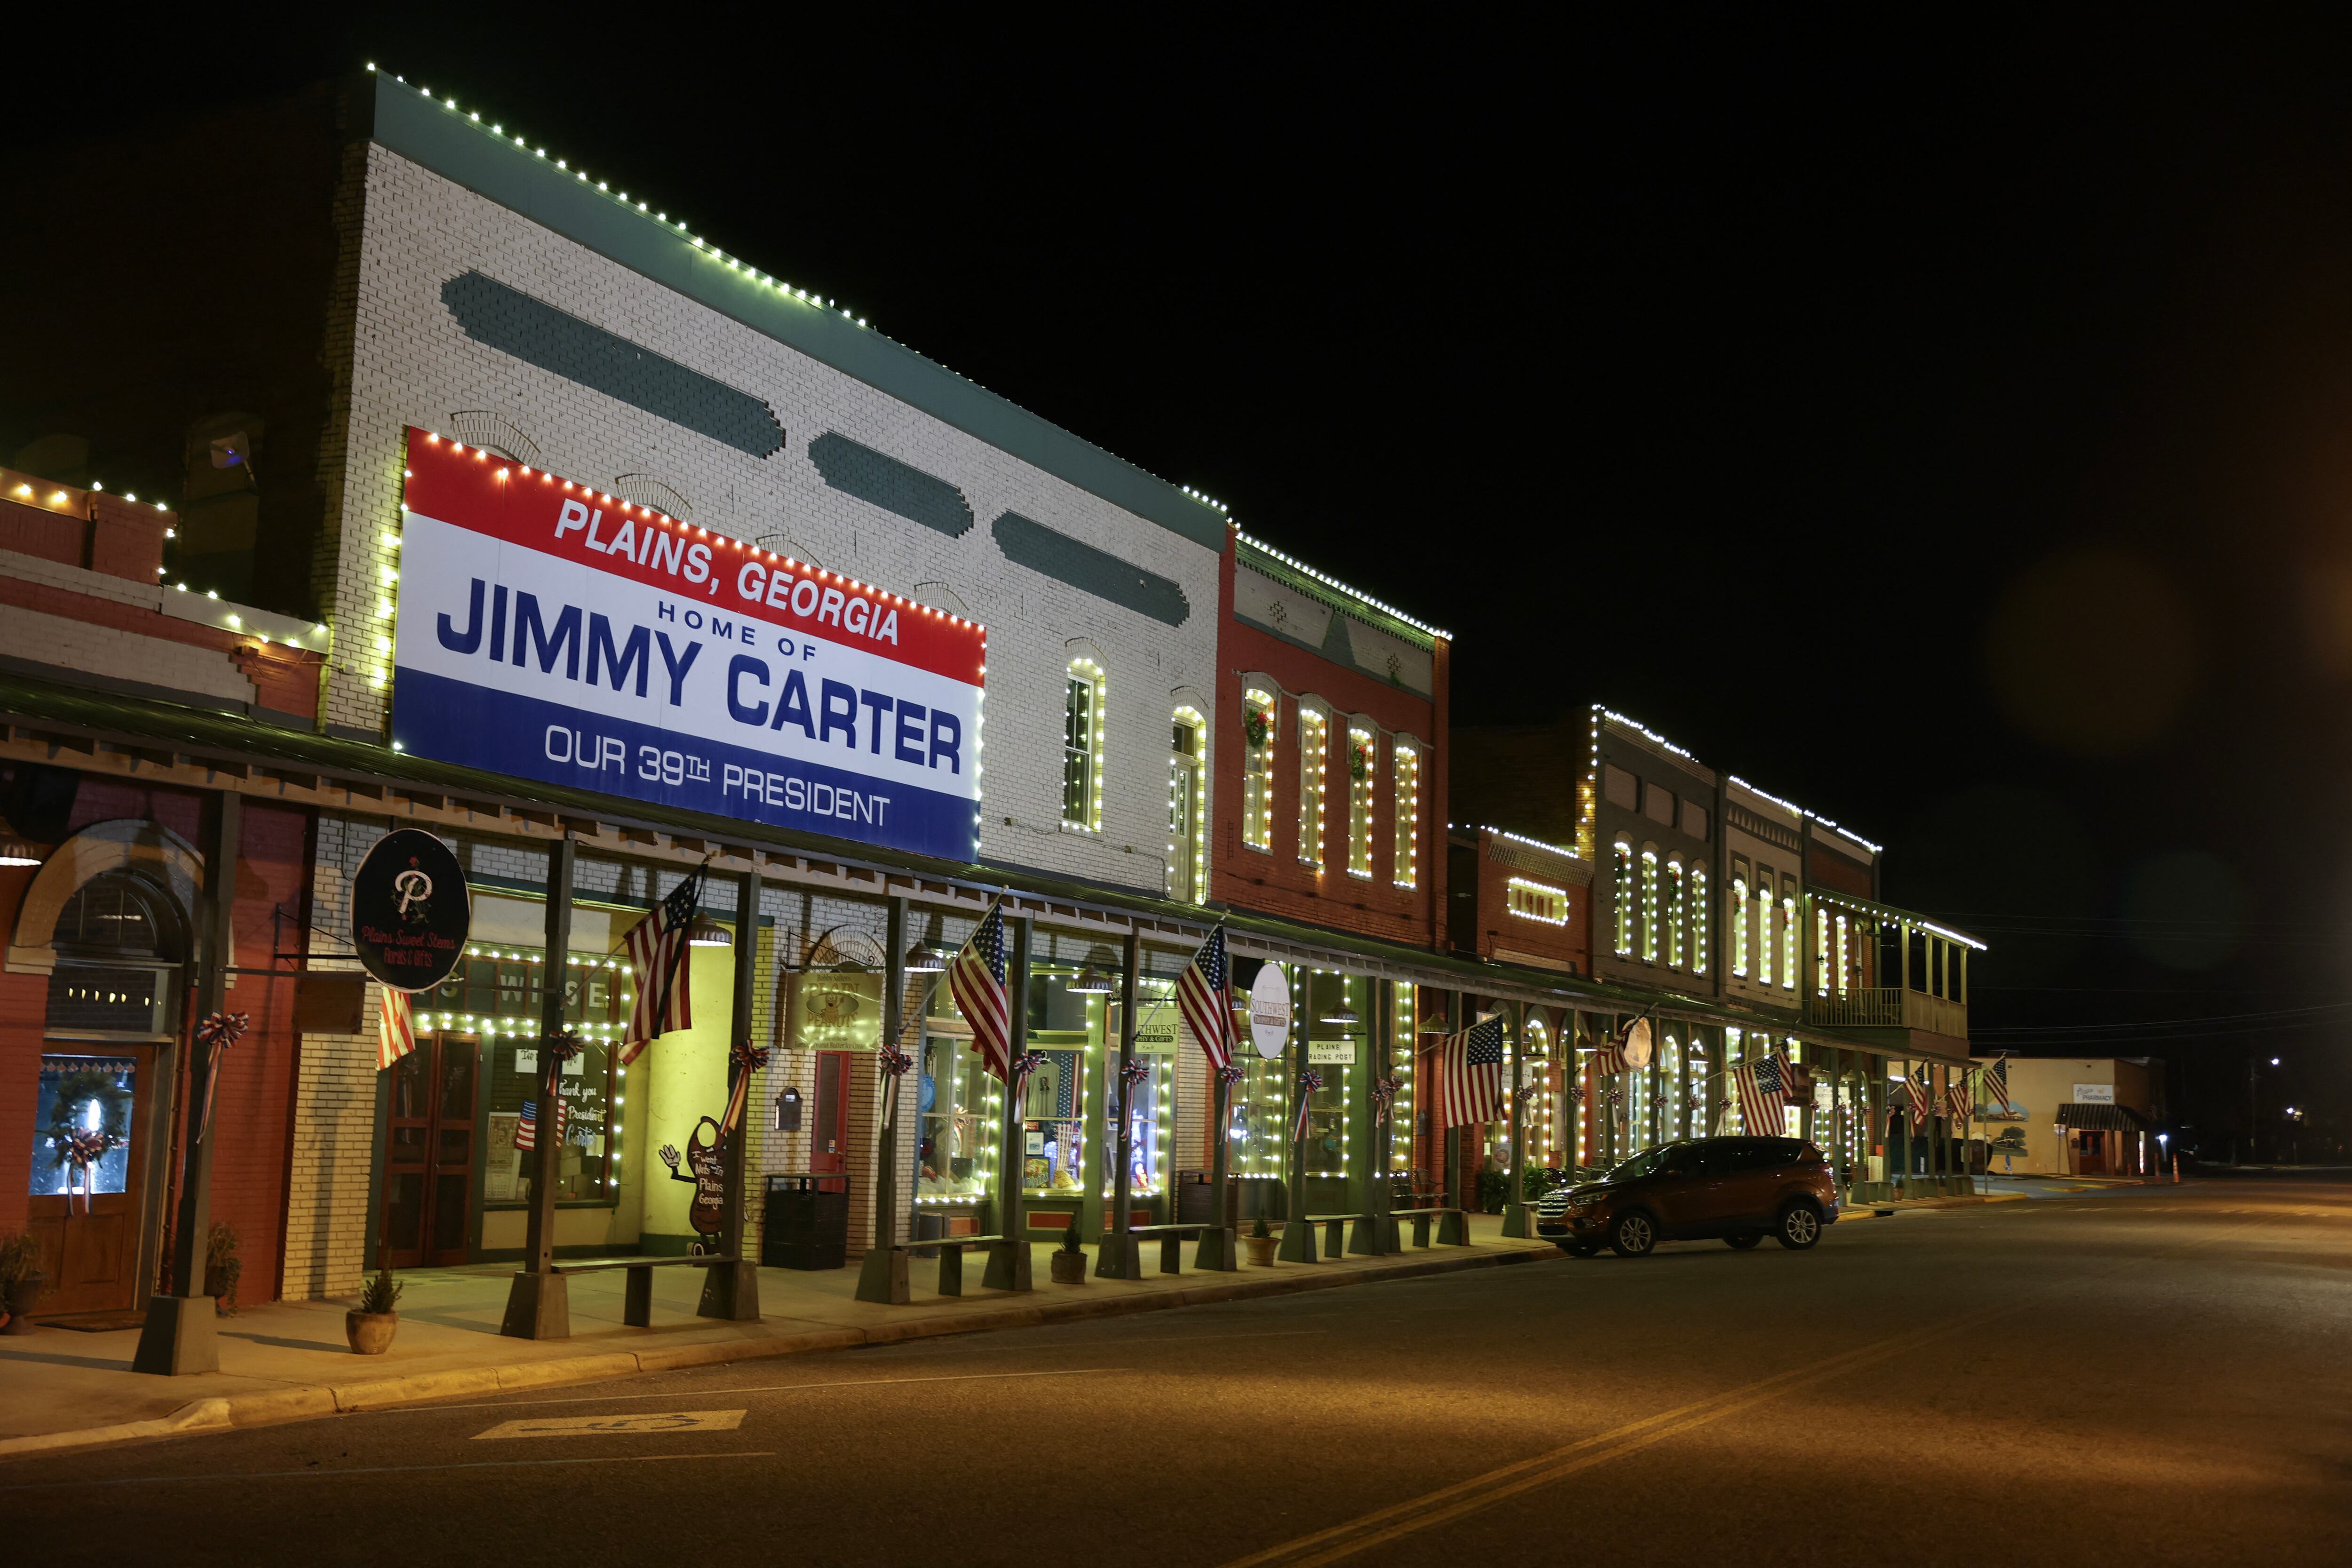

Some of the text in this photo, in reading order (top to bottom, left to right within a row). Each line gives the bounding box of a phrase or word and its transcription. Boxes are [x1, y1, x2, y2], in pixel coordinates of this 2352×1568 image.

[554, 498, 898, 645] PLAINS, GEORGIA
[659, 601, 817, 661] HOME OF
[437, 578, 962, 774] JIMMY CARTER
[545, 725, 890, 827] OUR 39TH PRESIDENT
[362, 926, 456, 949] Plains Sweet Stems
[1251, 998, 1289, 1016] SOUTHWEST
[582, 1087, 597, 1103] you
[567, 1105, 607, 1122] President
[695, 1163, 710, 1175] Nuts
